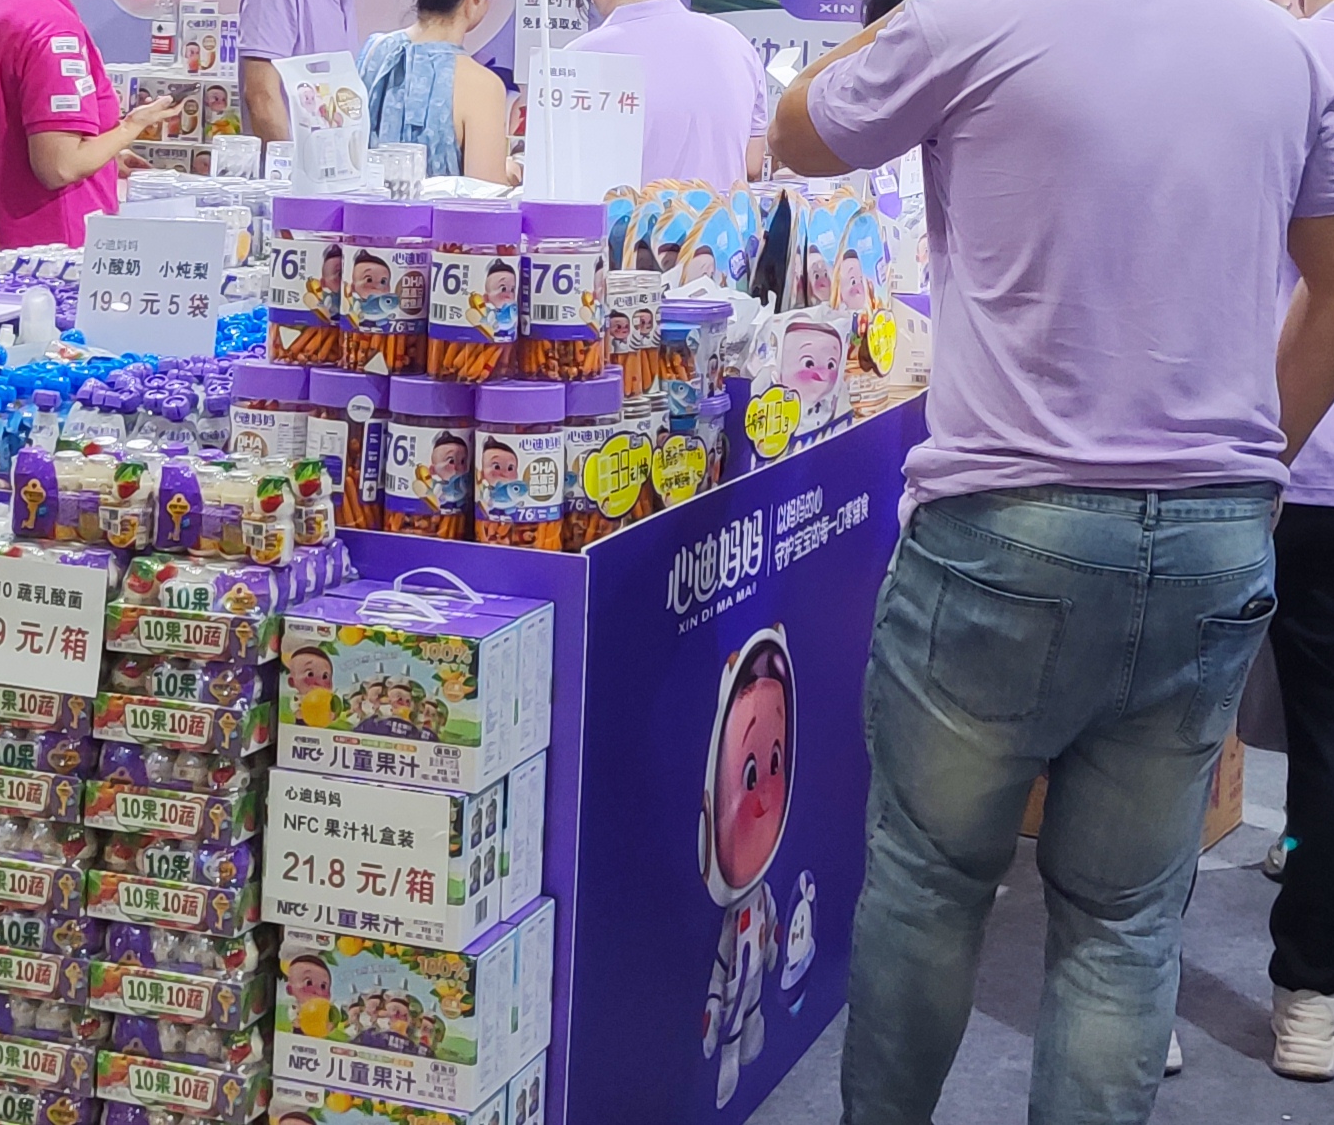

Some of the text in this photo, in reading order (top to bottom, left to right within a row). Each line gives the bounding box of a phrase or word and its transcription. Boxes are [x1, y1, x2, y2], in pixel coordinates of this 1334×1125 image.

[819, 4, 855, 14] XIN
[570, 89, 640, 114] 元 7 件
[92, 257, 141, 276] 小酸奶
[402, 276, 424, 287] DHA
[432, 262, 462, 295] 76
[532, 263, 575, 295] 76
[139, 292, 210, 318] 元 5 袋
[518, 436, 562, 452] 心迪妈妈
[529, 461, 556, 475] DHA
[666, 509, 764, 615] 心迪妈妈
[16, 583, 83, 610] 蔬乳酸菌
[164, 586, 212, 612] 10果
[677, 595, 734, 635] XIN DI MA
[16, 620, 90, 663] 元/箱
[143, 618, 227, 650] 10果10蔬
[419, 641, 472, 664] 100%
[153, 668, 198, 699] 10果
[130, 708, 207, 739] 10果10蔬
[329, 746, 420, 779] 儿童果汁
[120, 796, 197, 829] 10果10蔬
[284, 786, 342, 807] 心迪妈妈
[284, 813, 414, 849] NFC 果汁礼盒装
[145, 847, 191, 880] 10果
[282, 852, 436, 905] 21.8 元/箱
[123, 884, 202, 925] 10果10蔬
[313, 904, 405, 937] 儿童果汁
[127, 974, 205, 1012] 10果10蔬
[134, 1069, 210, 1102] 10果10蔬
[326, 1056, 417, 1093] 儿童果汁
